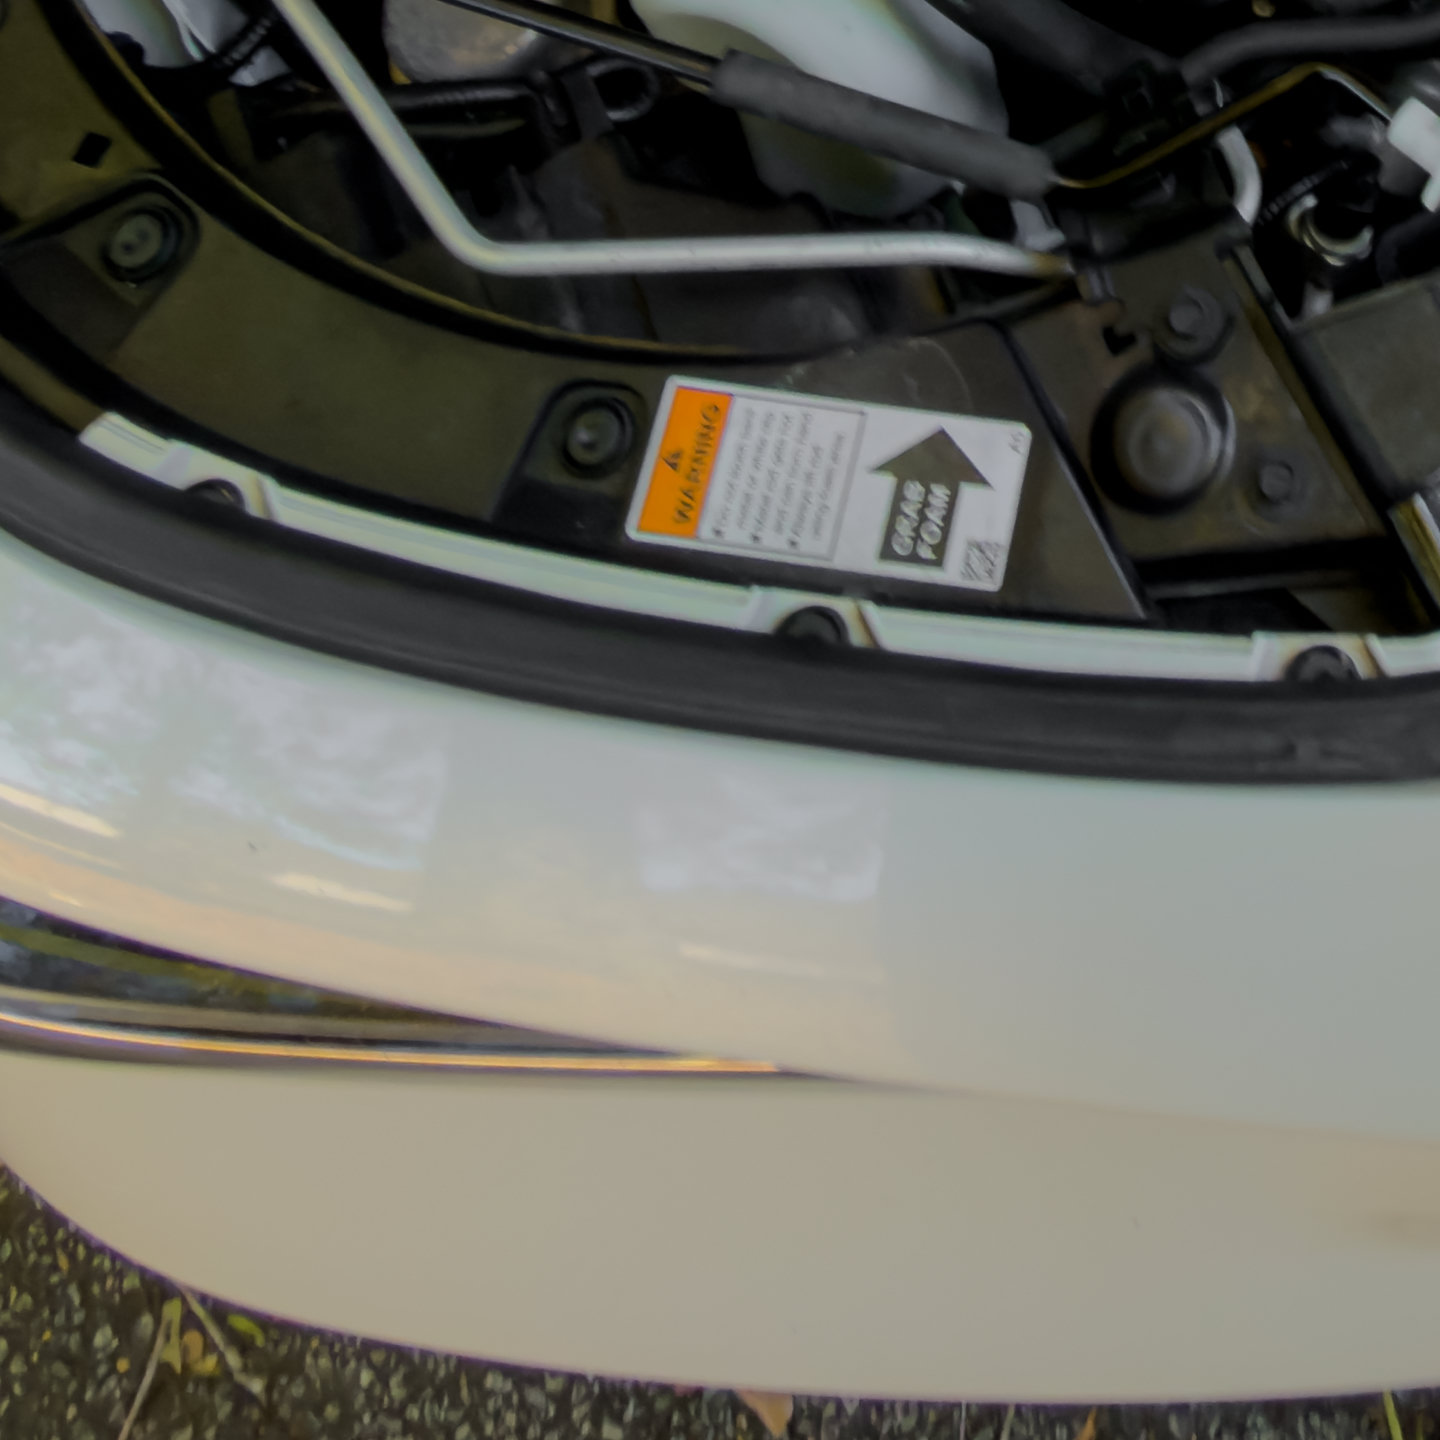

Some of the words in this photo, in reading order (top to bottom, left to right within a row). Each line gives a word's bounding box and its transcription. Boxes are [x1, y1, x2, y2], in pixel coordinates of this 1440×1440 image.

[673, 403, 719, 525] WARNING
[890, 478, 926, 557] GRAB
[915, 481, 951, 561] FOAM
